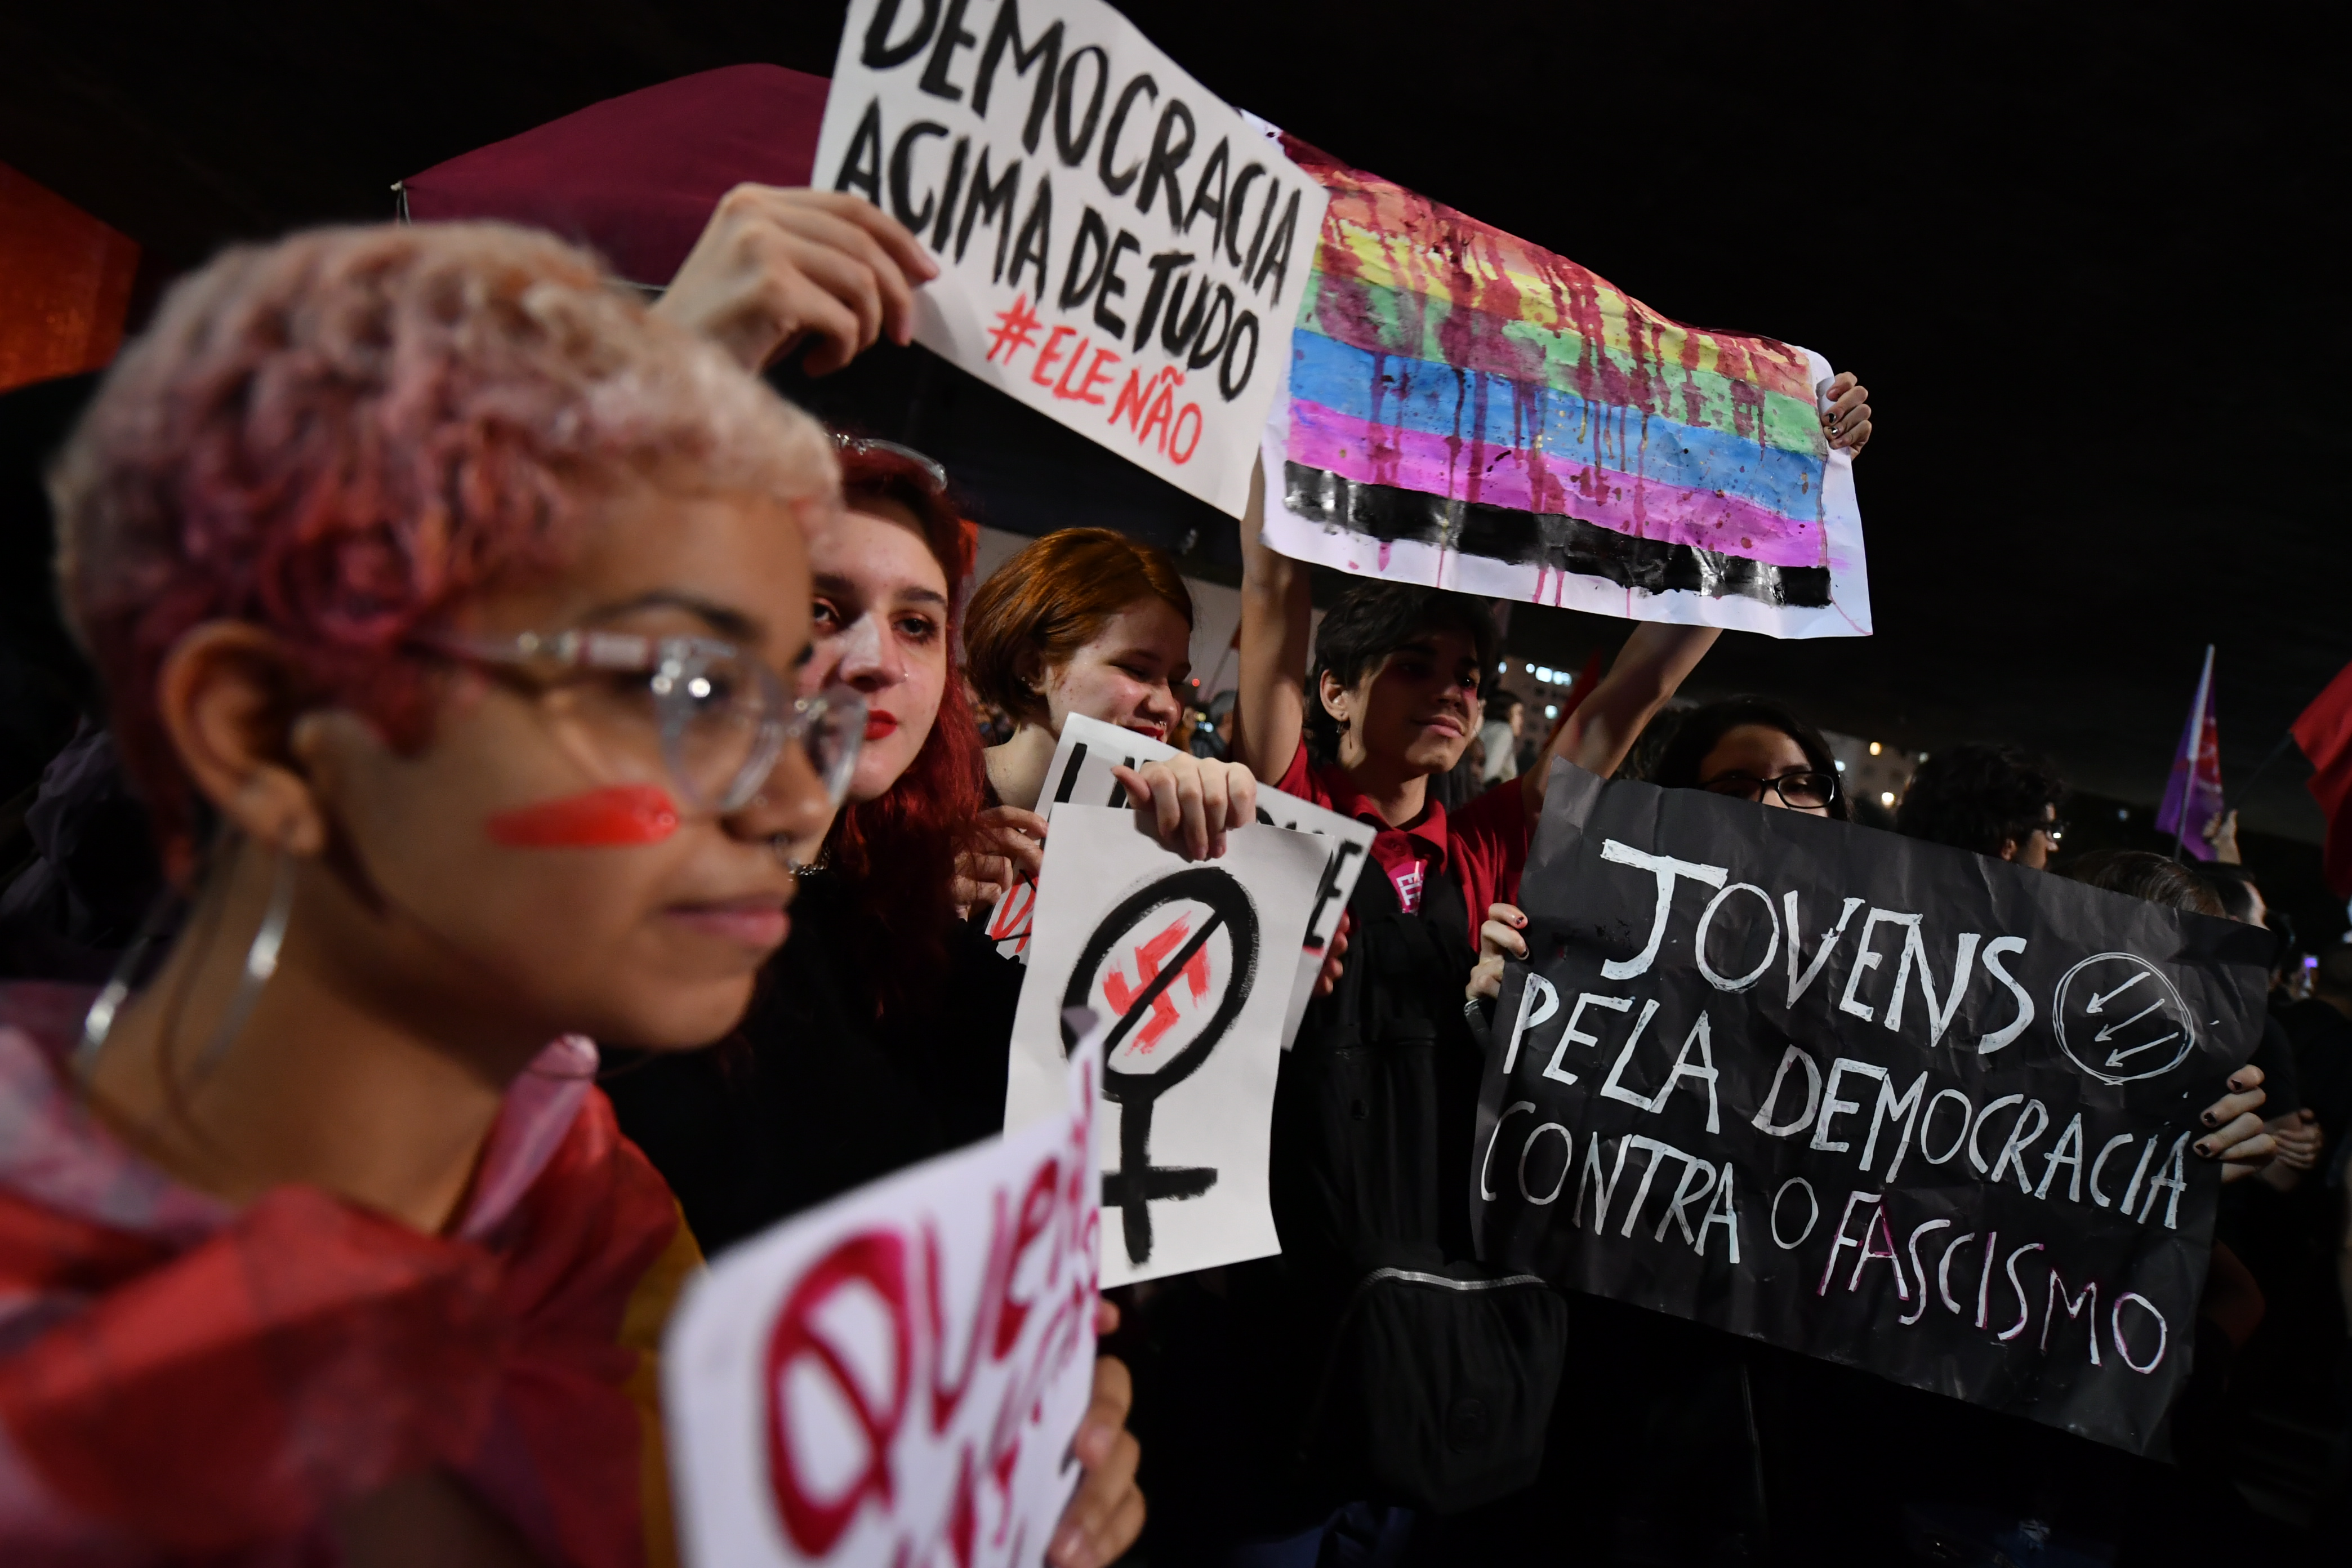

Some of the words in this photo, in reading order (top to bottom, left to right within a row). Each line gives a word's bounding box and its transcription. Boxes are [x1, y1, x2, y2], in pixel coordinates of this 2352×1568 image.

[834, 95, 1053, 304] ACIMA
[1058, 206, 1142, 341] DE
[1132, 252, 1259, 402] TUDO
[861, 0, 1302, 306] DEMOCRACIA
[1601, 839, 2036, 1054] JOVENS
[1481, 1101, 1740, 1263] CONTRA
[1771, 1177, 1818, 1249] O
[1817, 1191, 2167, 1374] FASCISMO
[1503, 973, 1720, 1134] PELA
[1751, 1045, 2191, 1229] DEMOCRACIA
